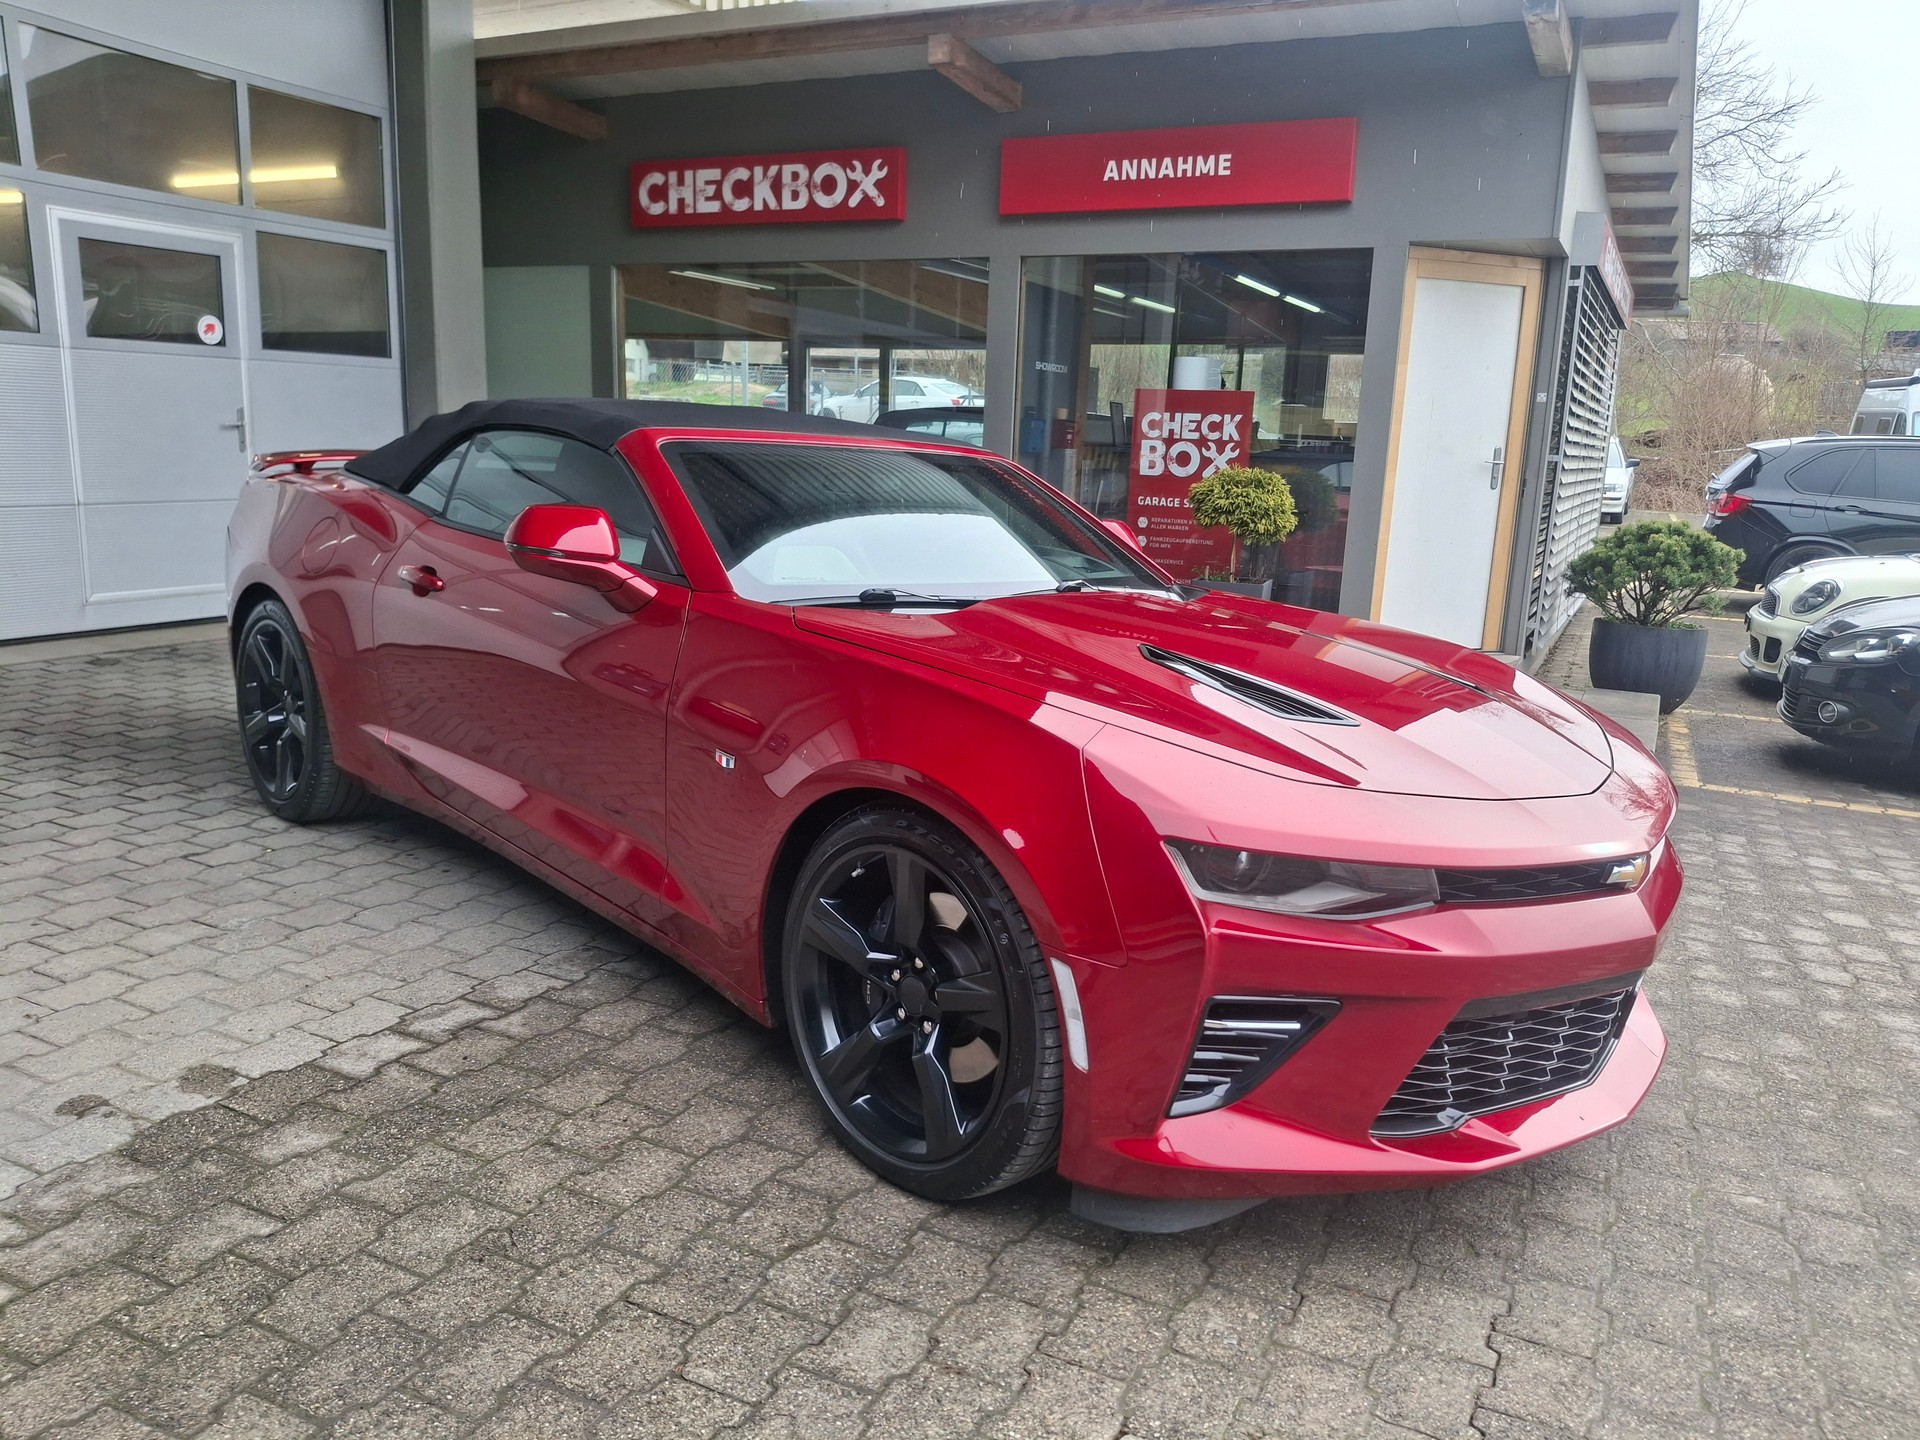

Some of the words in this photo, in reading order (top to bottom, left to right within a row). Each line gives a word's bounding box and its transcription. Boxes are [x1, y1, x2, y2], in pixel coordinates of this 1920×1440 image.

[1103, 154, 1232, 182] ANNAHME
[638, 159, 888, 215] CHECKBOX
[1141, 411, 1243, 441] CHECK
[1139, 439, 1240, 479] BOX
[1138, 496, 1180, 507] GARAGE
[1151, 517, 1188, 525] REPARATUREN
